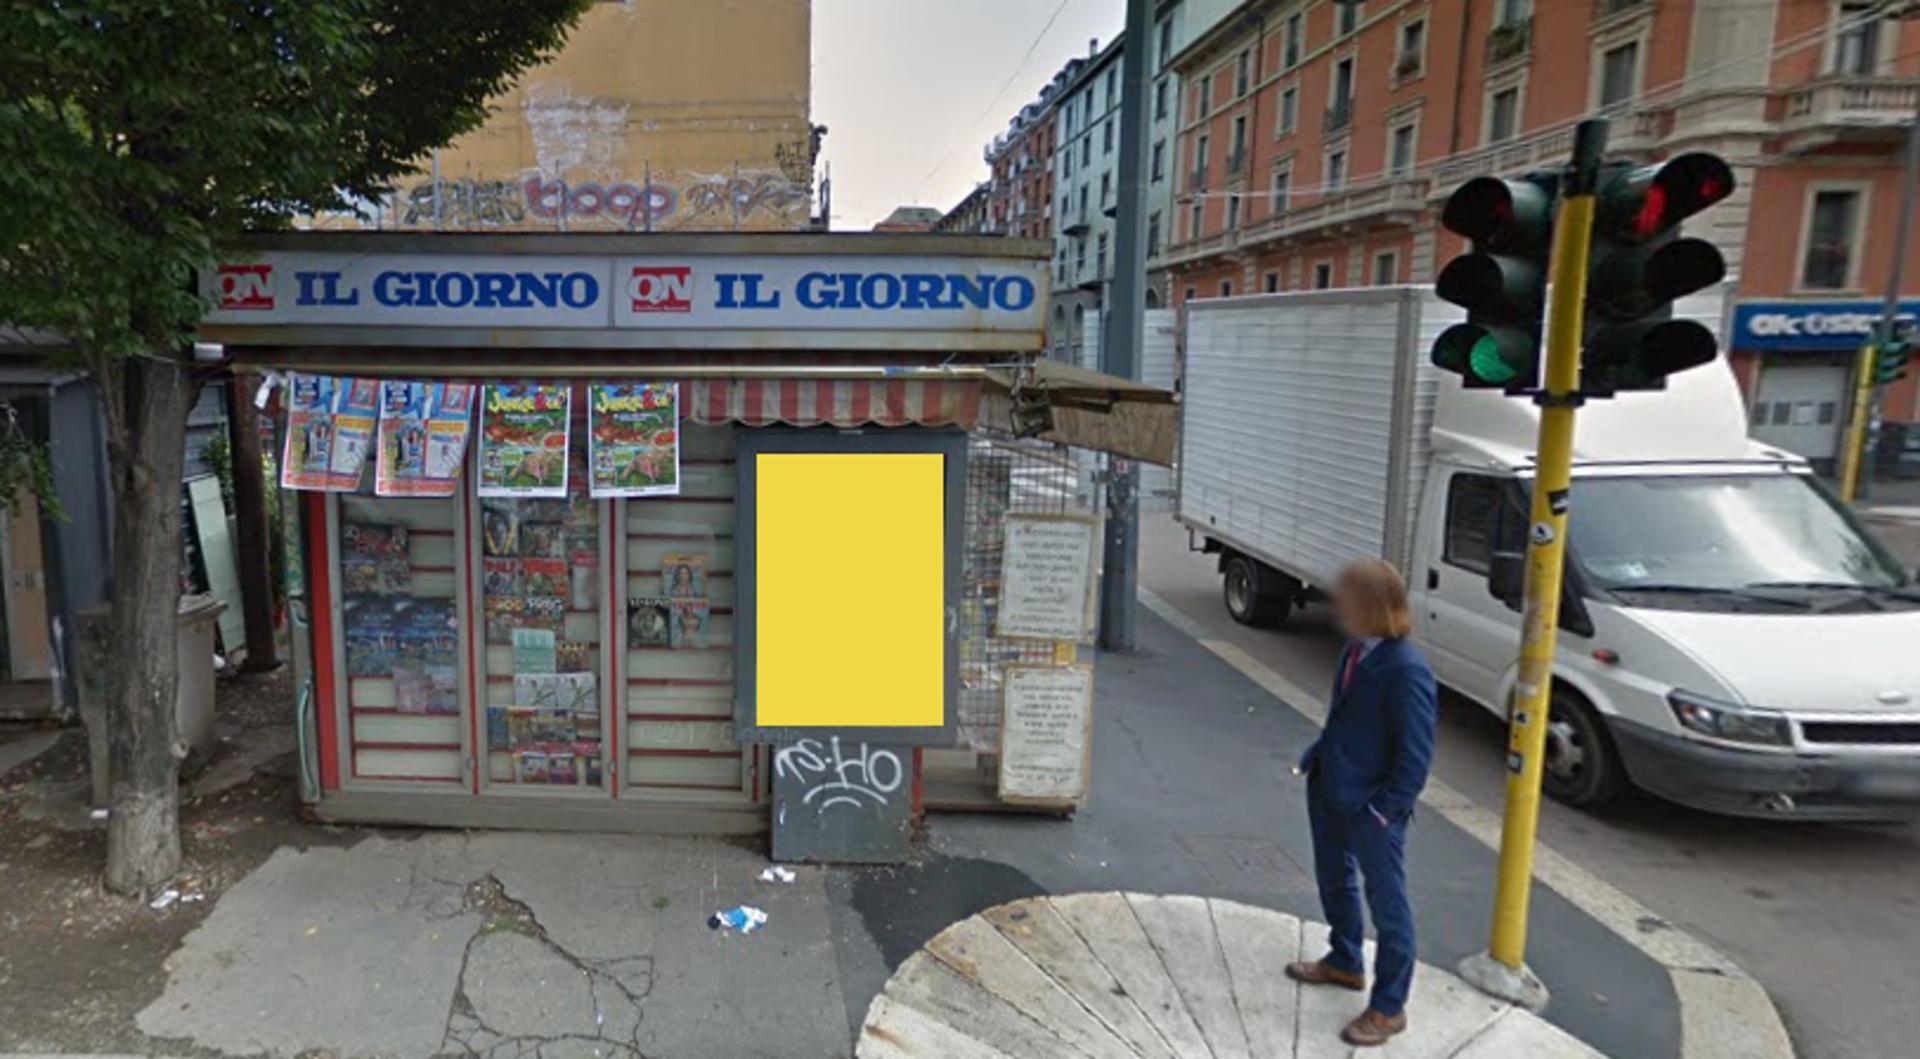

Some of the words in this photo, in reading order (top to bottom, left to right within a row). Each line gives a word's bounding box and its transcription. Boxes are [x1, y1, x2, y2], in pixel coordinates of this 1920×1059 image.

[296, 272, 359, 306] IL
[373, 272, 600, 309] GIORNO
[626, 271, 693, 305] QN
[714, 273, 781, 309] IL
[796, 272, 1036, 311] GIORNO
